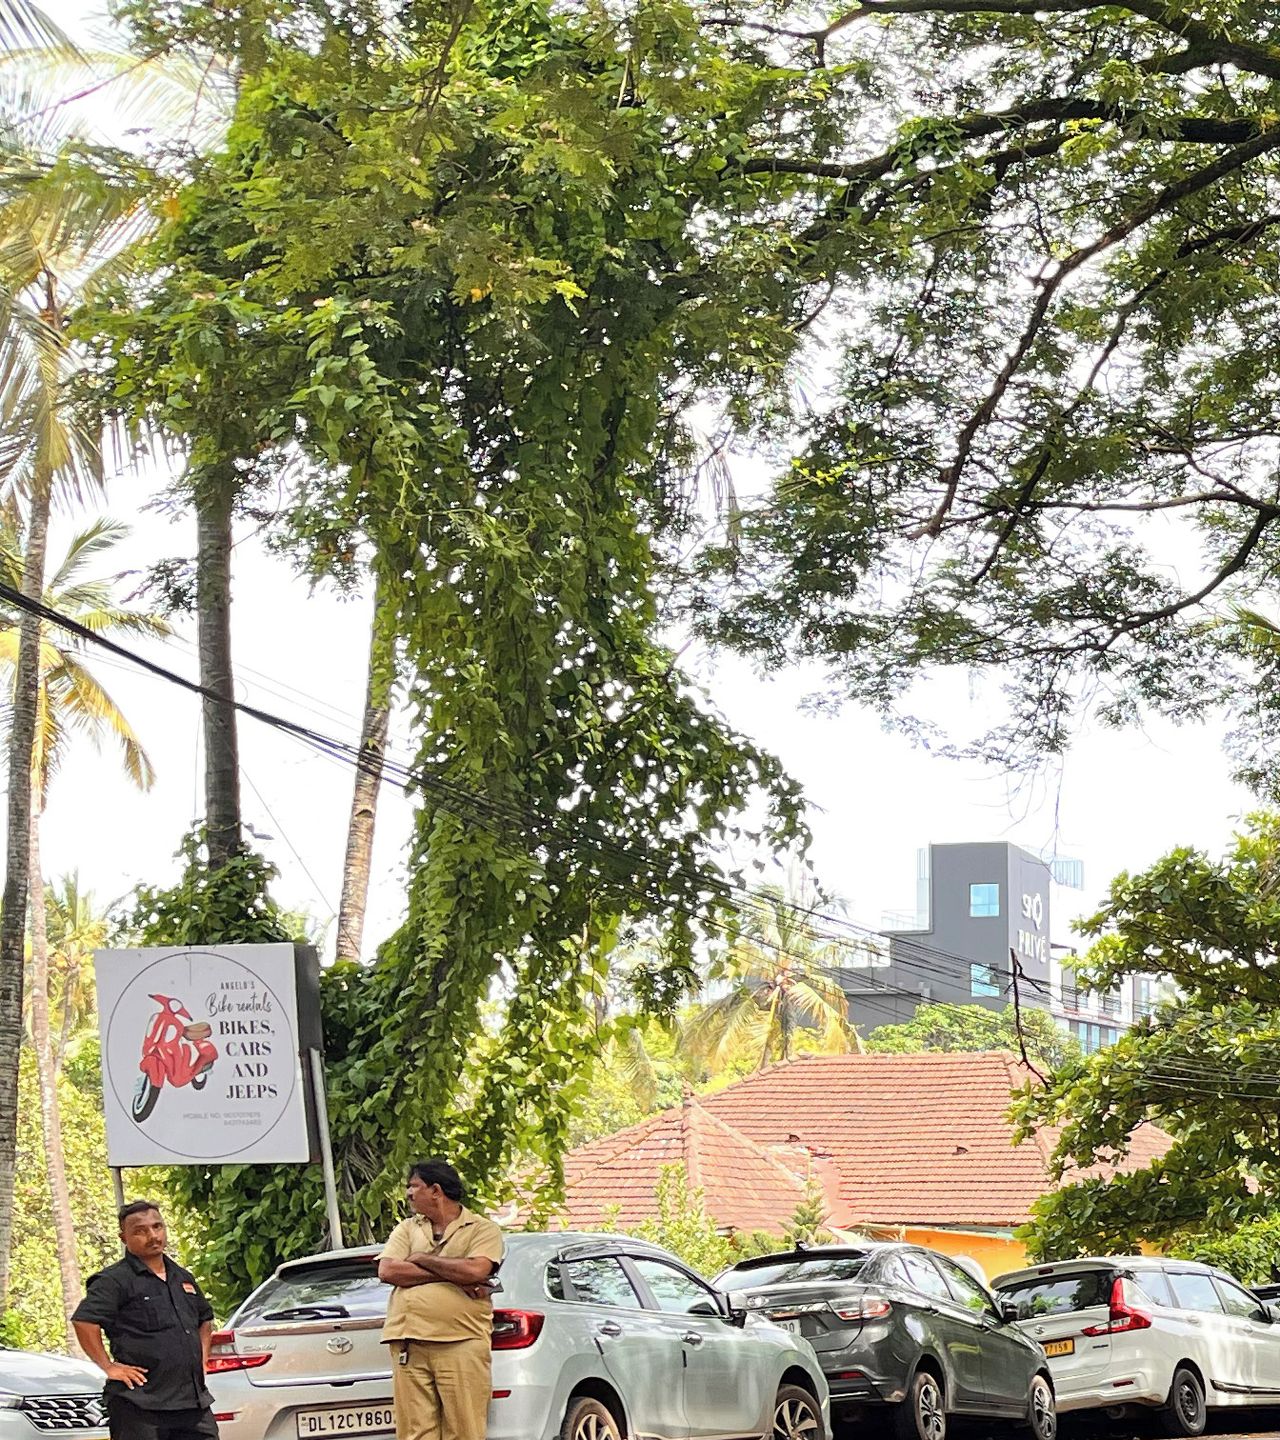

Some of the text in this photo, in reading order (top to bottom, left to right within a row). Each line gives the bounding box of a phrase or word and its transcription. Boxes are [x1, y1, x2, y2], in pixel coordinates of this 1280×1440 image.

[205, 992, 272, 1017] Bike rentals
[219, 1019, 276, 1036] BIKES,
[225, 1041, 272, 1057] CARS
[232, 1063, 268, 1078] AND
[225, 1084, 278, 1100] JEEPS
[308, 1409, 397, 1432] DL12CY860
